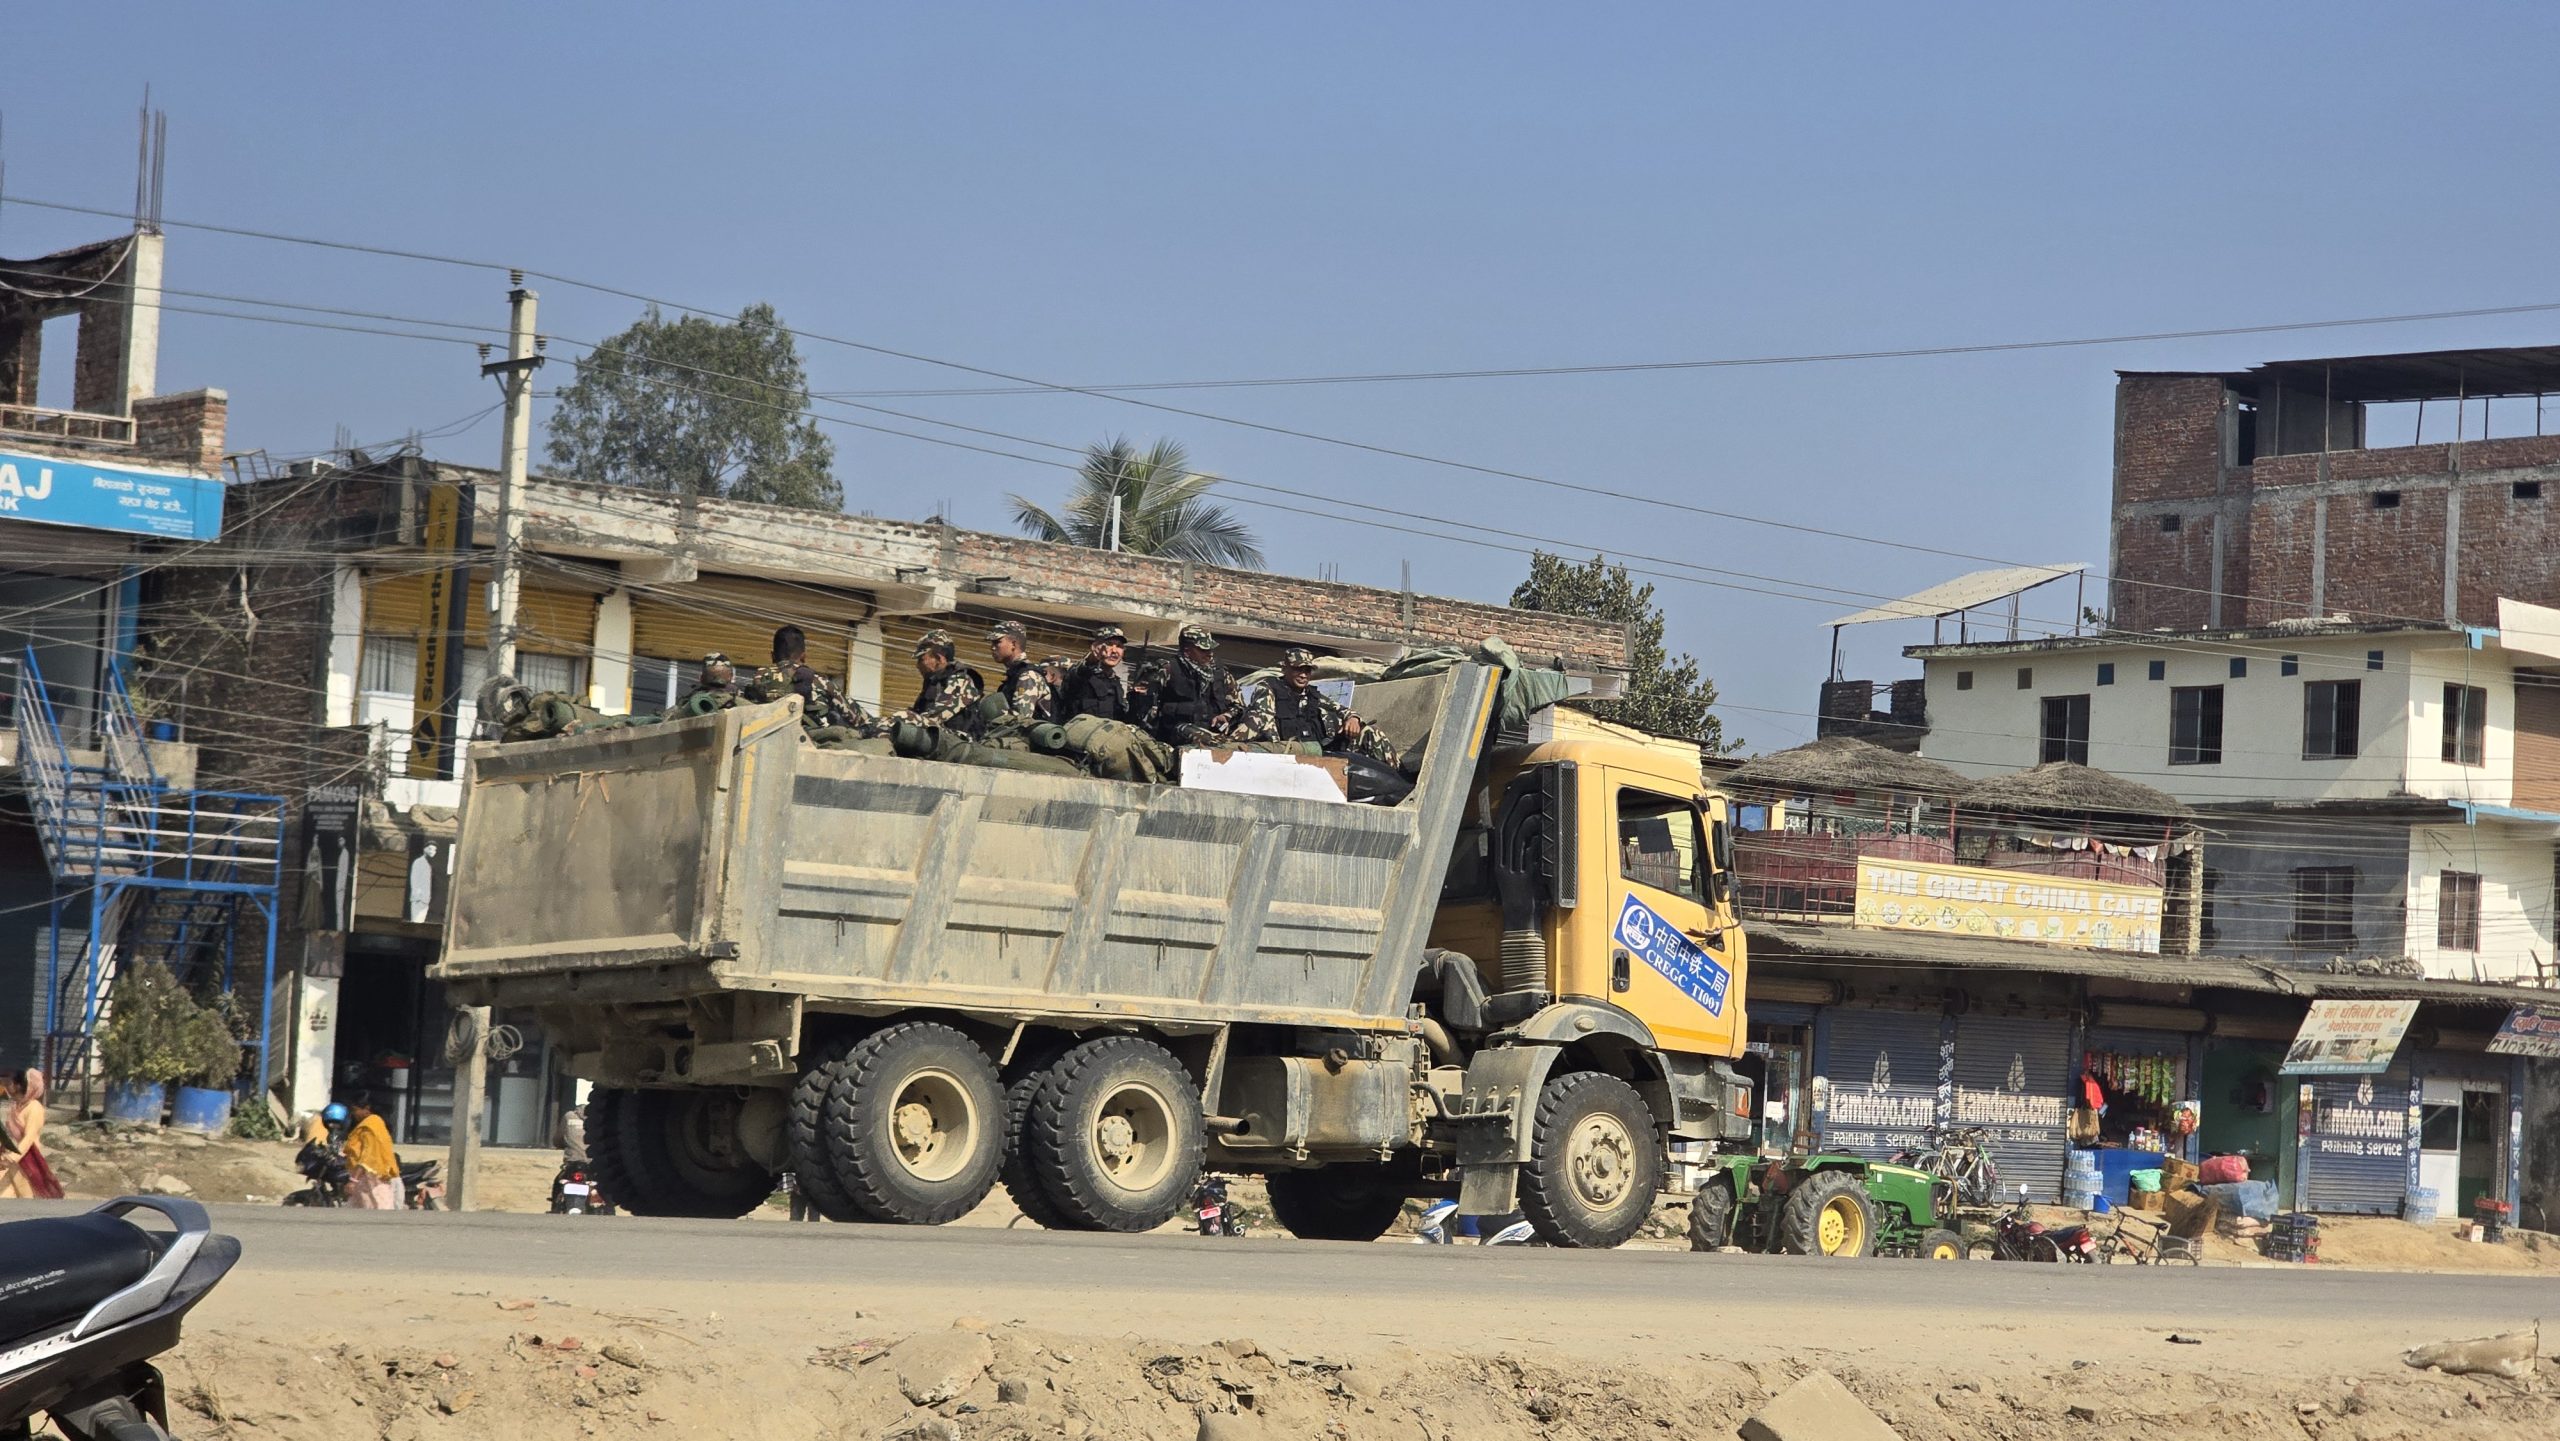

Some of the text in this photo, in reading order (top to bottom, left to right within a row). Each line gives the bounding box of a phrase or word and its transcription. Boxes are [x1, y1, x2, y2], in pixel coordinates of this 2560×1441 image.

[422, 554, 446, 702] Siddharth
[1866, 868, 2161, 922] THE GREAT CHINA CAFE
[1646, 949, 1688, 988] CREGC
[1655, 926, 1726, 997] 中国中铁二局
[1829, 1085, 1934, 1126] kamdooo.com
[1958, 1084, 2061, 1125] kamdooo.com
[2316, 1098, 2404, 1139] kamdooo.com
